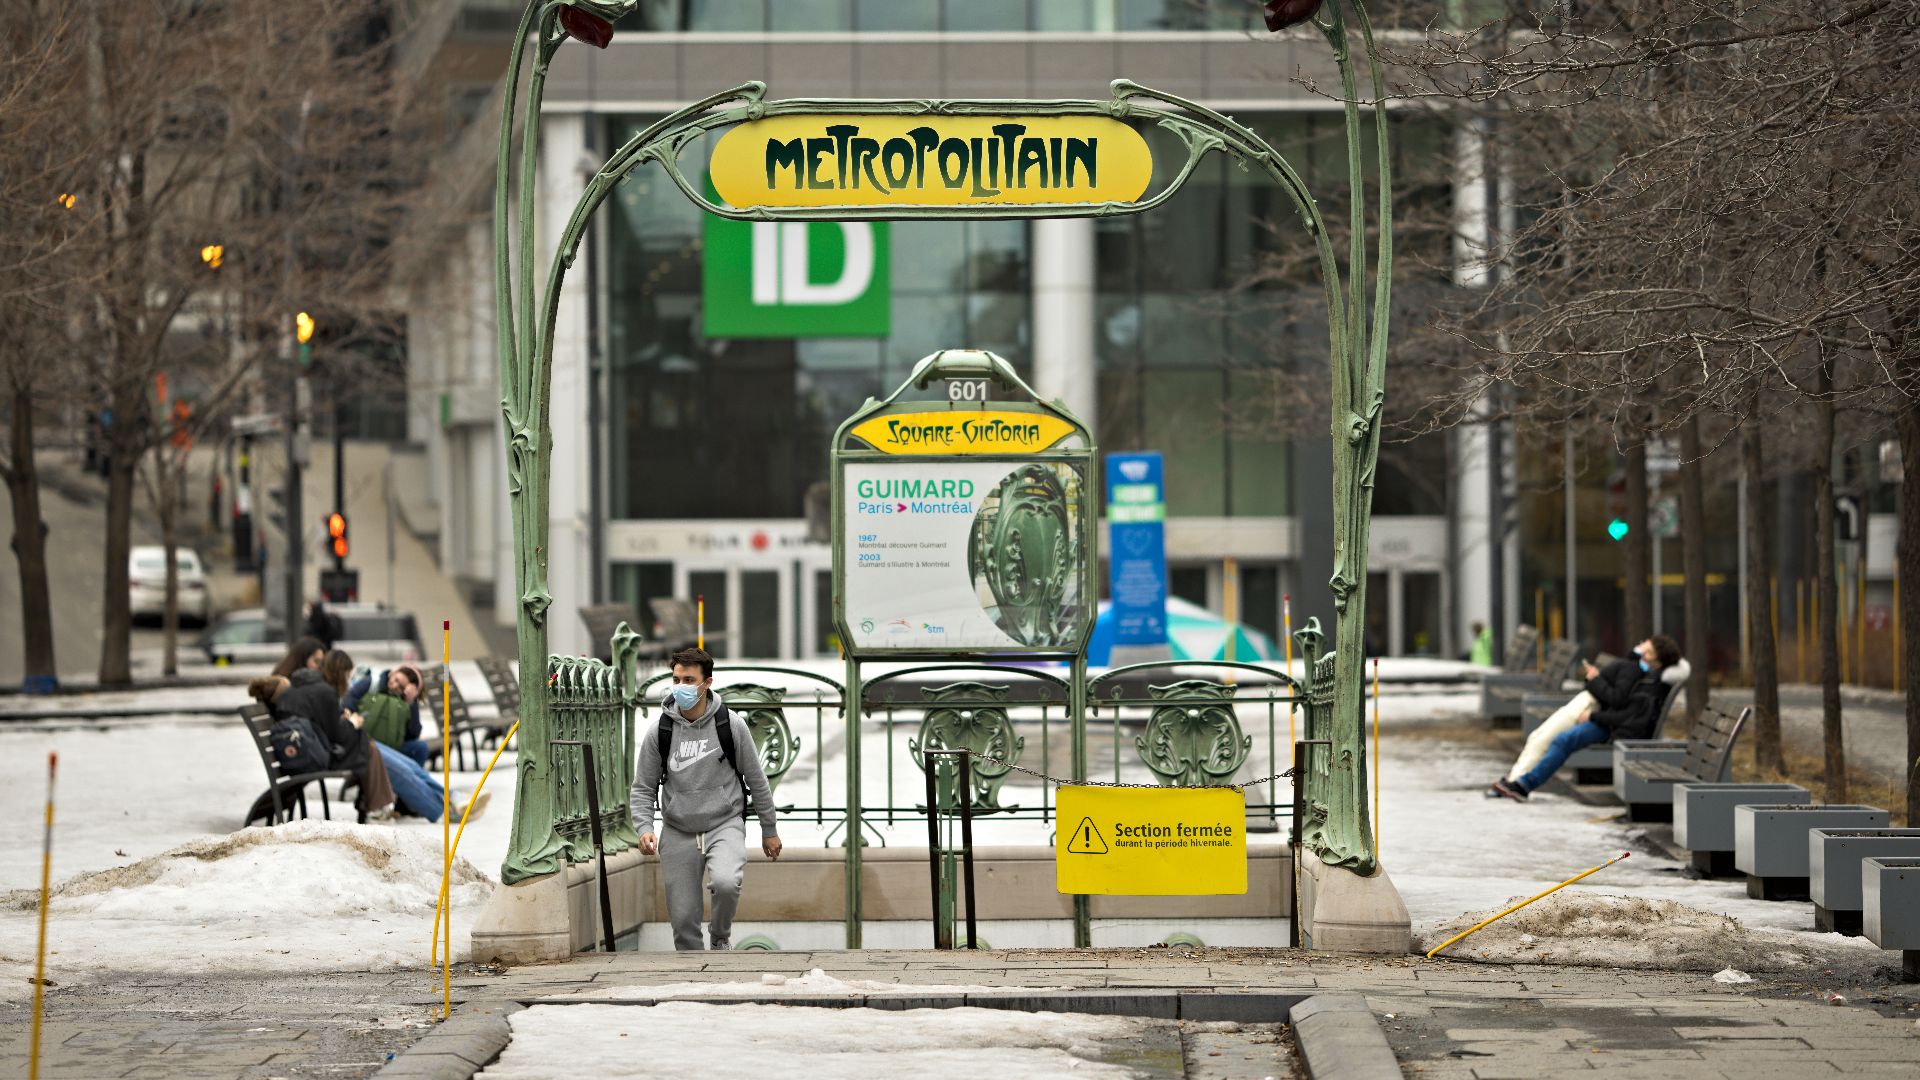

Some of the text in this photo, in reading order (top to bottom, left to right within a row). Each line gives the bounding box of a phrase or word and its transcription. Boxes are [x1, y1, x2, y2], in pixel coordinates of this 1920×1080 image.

[765, 123, 1098, 198] METROPOLITAIN
[948, 381, 988, 401] 601
[857, 479, 974, 499] GUIMARD
[858, 501, 973, 514] Paris Montréal
[858, 534, 877, 542] 1967
[858, 553, 881, 561] 2003
[927, 625, 944, 634] stm
[678, 738, 709, 758] NIKE
[1115, 822, 1232, 838] Section fermée
[1115, 839, 1233, 850] durant la période hivernale.
